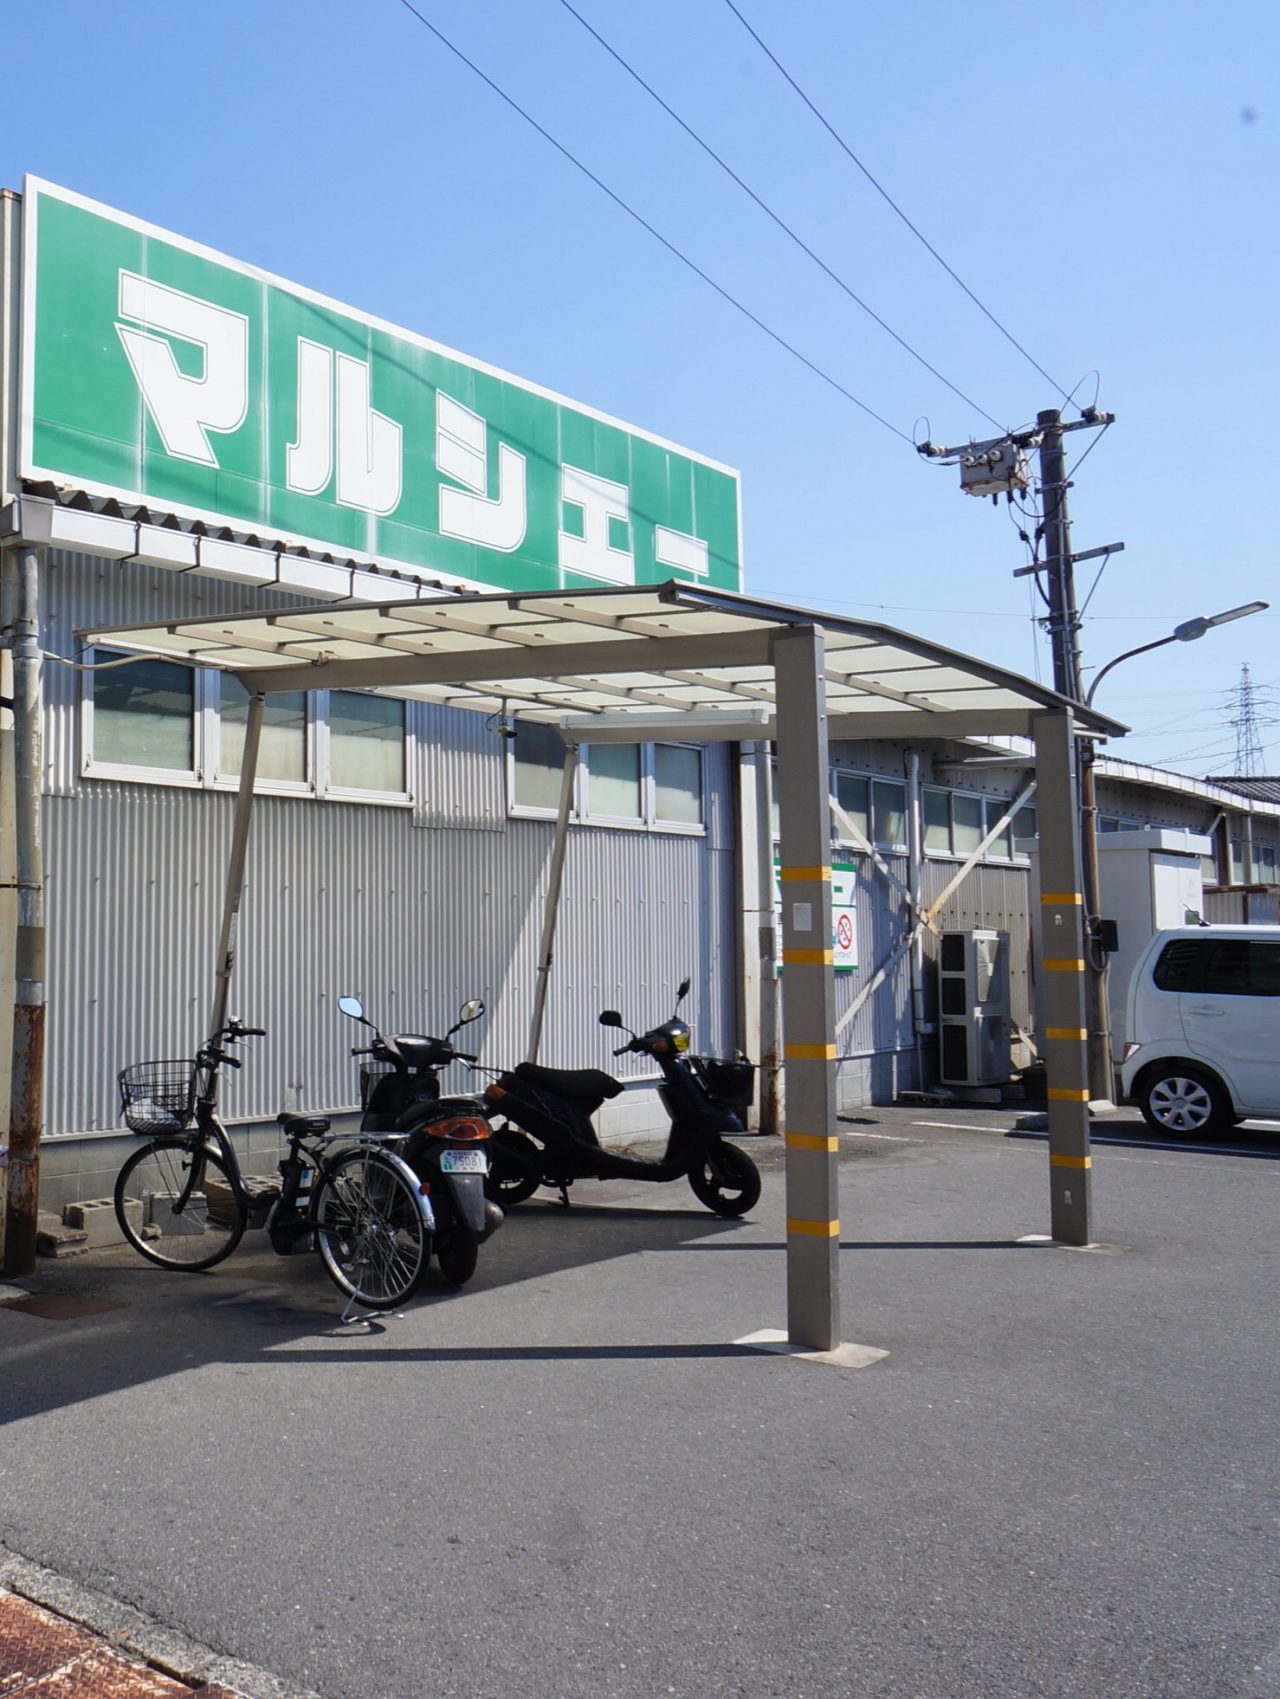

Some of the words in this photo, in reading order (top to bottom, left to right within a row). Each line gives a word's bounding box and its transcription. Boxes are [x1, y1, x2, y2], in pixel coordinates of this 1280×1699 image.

[114, 268, 710, 586] マルシェー
